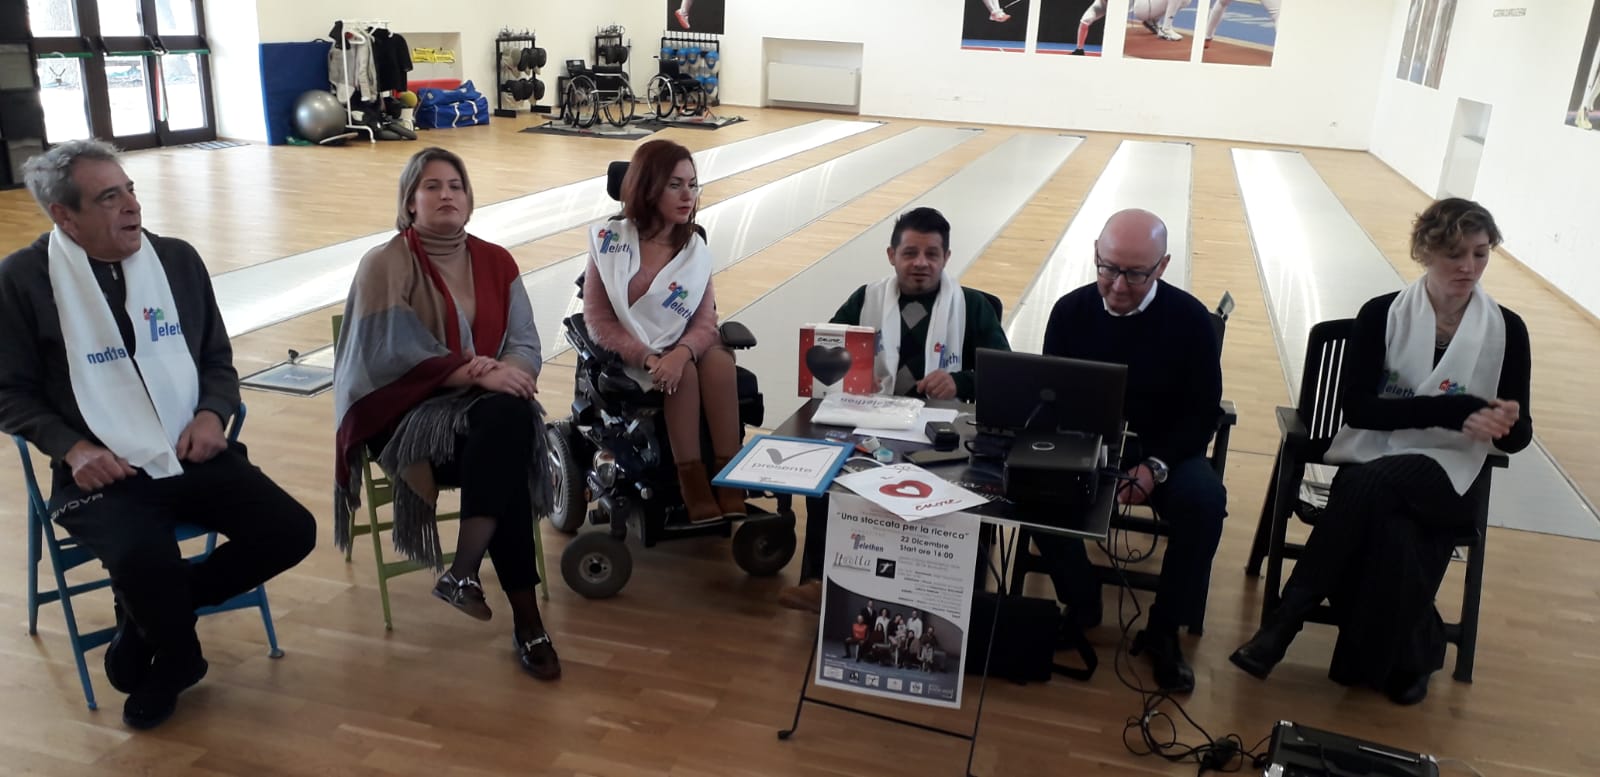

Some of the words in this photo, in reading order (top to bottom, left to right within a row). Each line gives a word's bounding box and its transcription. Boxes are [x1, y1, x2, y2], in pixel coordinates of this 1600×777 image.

[860, 514, 901, 529] stoccata
[902, 523, 918, 532] per
[920, 525, 929, 535] la
[912, 536, 950, 550] Dicembre
[918, 548, 931, 556] ore
